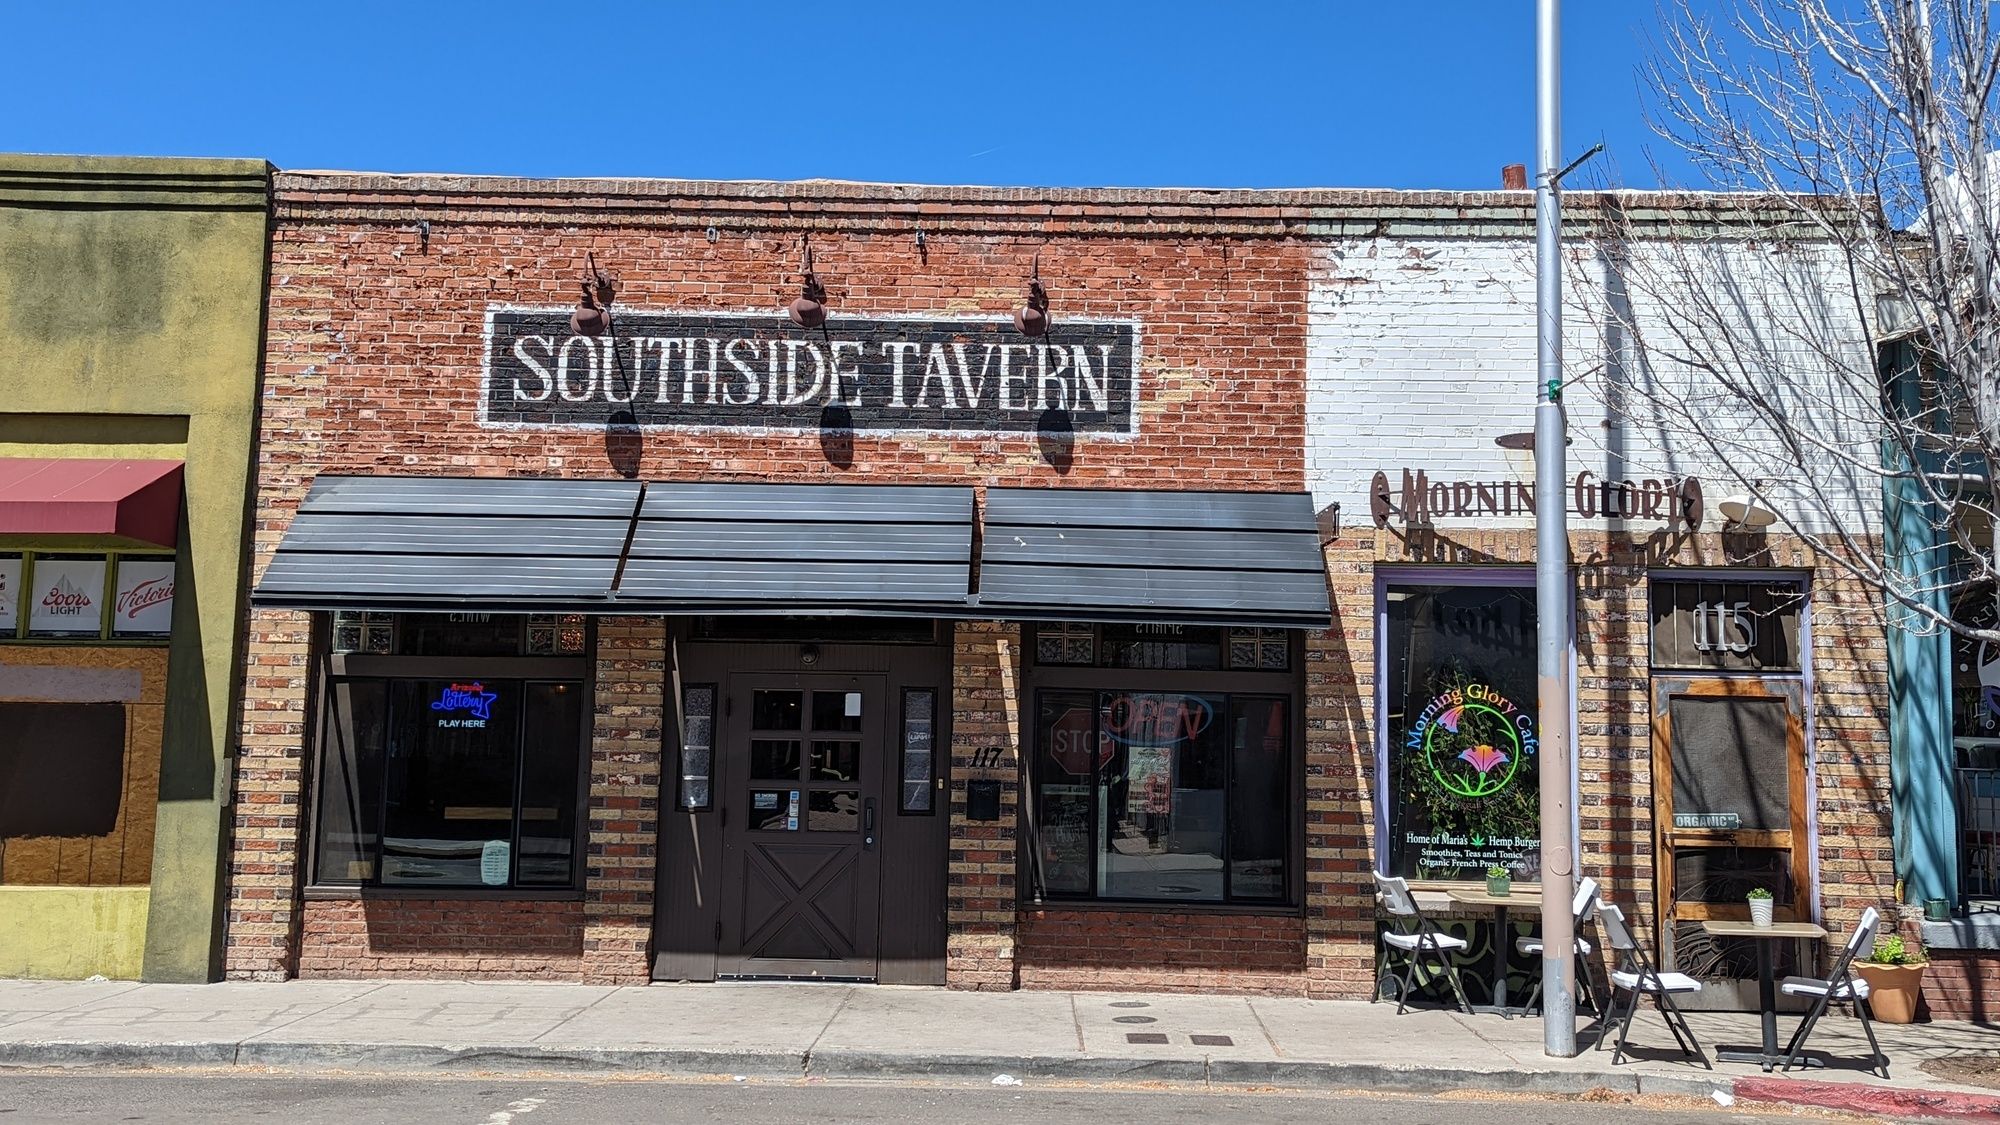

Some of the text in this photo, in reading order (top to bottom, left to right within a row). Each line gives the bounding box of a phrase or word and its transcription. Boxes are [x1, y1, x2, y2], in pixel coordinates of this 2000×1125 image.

[513, 335, 1114, 411] SOUTHSIDE TAVERN
[1398, 467, 1682, 524] MORNIN GLORY
[42, 587, 92, 606] Coors
[50, 606, 82, 615] LIGHT
[1696, 601, 1754, 652] 115
[432, 688, 484, 715] Lottery
[438, 719, 486, 728] PLAY HERE
[1106, 697, 1204, 741] OPEN
[1406, 683, 1540, 755] Morning Glory Cafe
[1055, 729, 1111, 754] STOP
[970, 746, 1005, 768] 117
[1675, 816, 1727, 827] ORGANIC
[1406, 832, 1430, 844] Home
[1432, 833, 1440, 845] of
[1442, 833, 1468, 846] Maria's
[1489, 835, 1513, 849] Hemp
[1419, 858, 1525, 869] Organic French Press Coffee
[1421, 847, 1523, 859] Smoothies, Teas and Tonics
